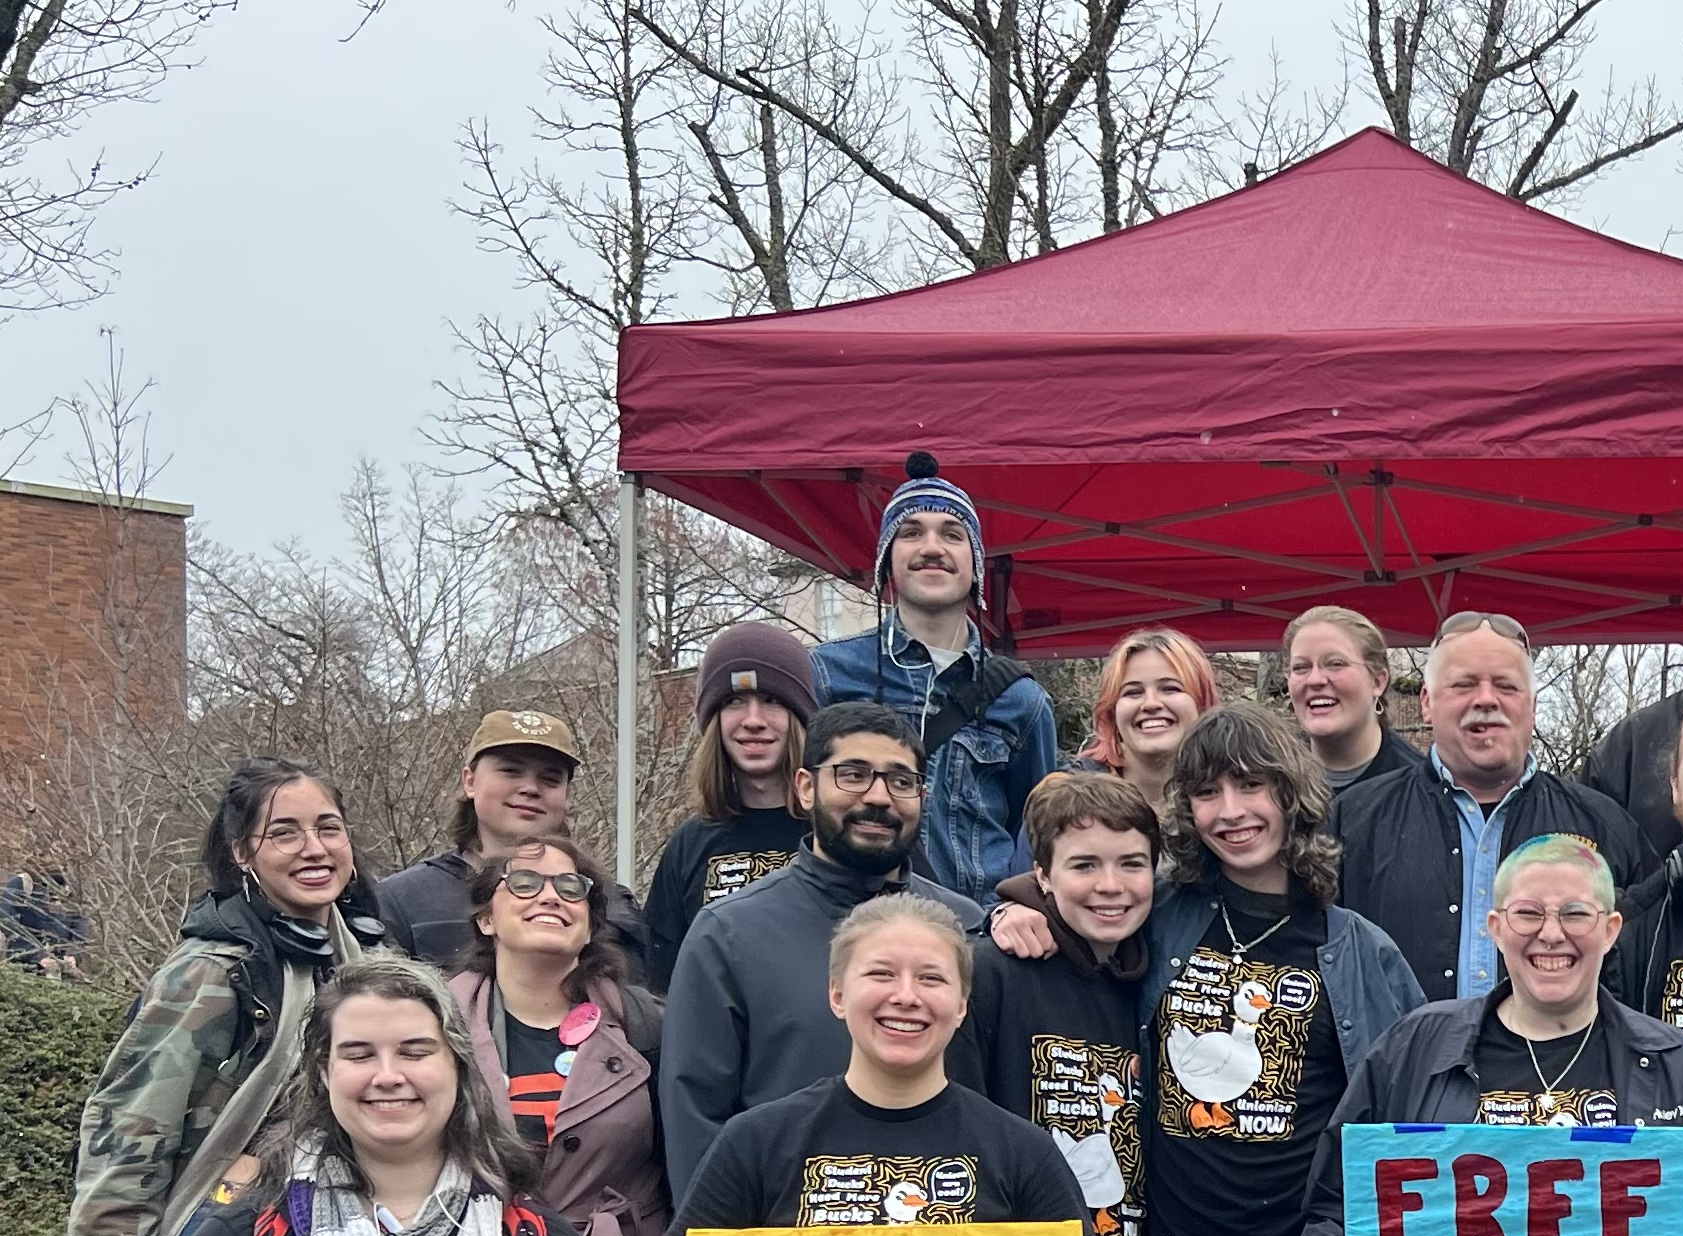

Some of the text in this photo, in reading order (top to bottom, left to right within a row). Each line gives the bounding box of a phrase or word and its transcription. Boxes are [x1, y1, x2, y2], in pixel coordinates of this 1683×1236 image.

[1200, 983, 1231, 997] More
[1170, 995, 1224, 1017] Bucks
[1047, 1099, 1098, 1116] Bucks
[1237, 1099, 1293, 1113] Unionize
[1483, 1100, 1530, 1112] Student
[1239, 1115, 1287, 1134] NOW
[1488, 1113, 1525, 1125] Ducks
[824, 1165, 872, 1176] Student
[827, 1178, 866, 1189] Ducks
[808, 1191, 880, 1203] Need More
[813, 1207, 875, 1222] Bucks
